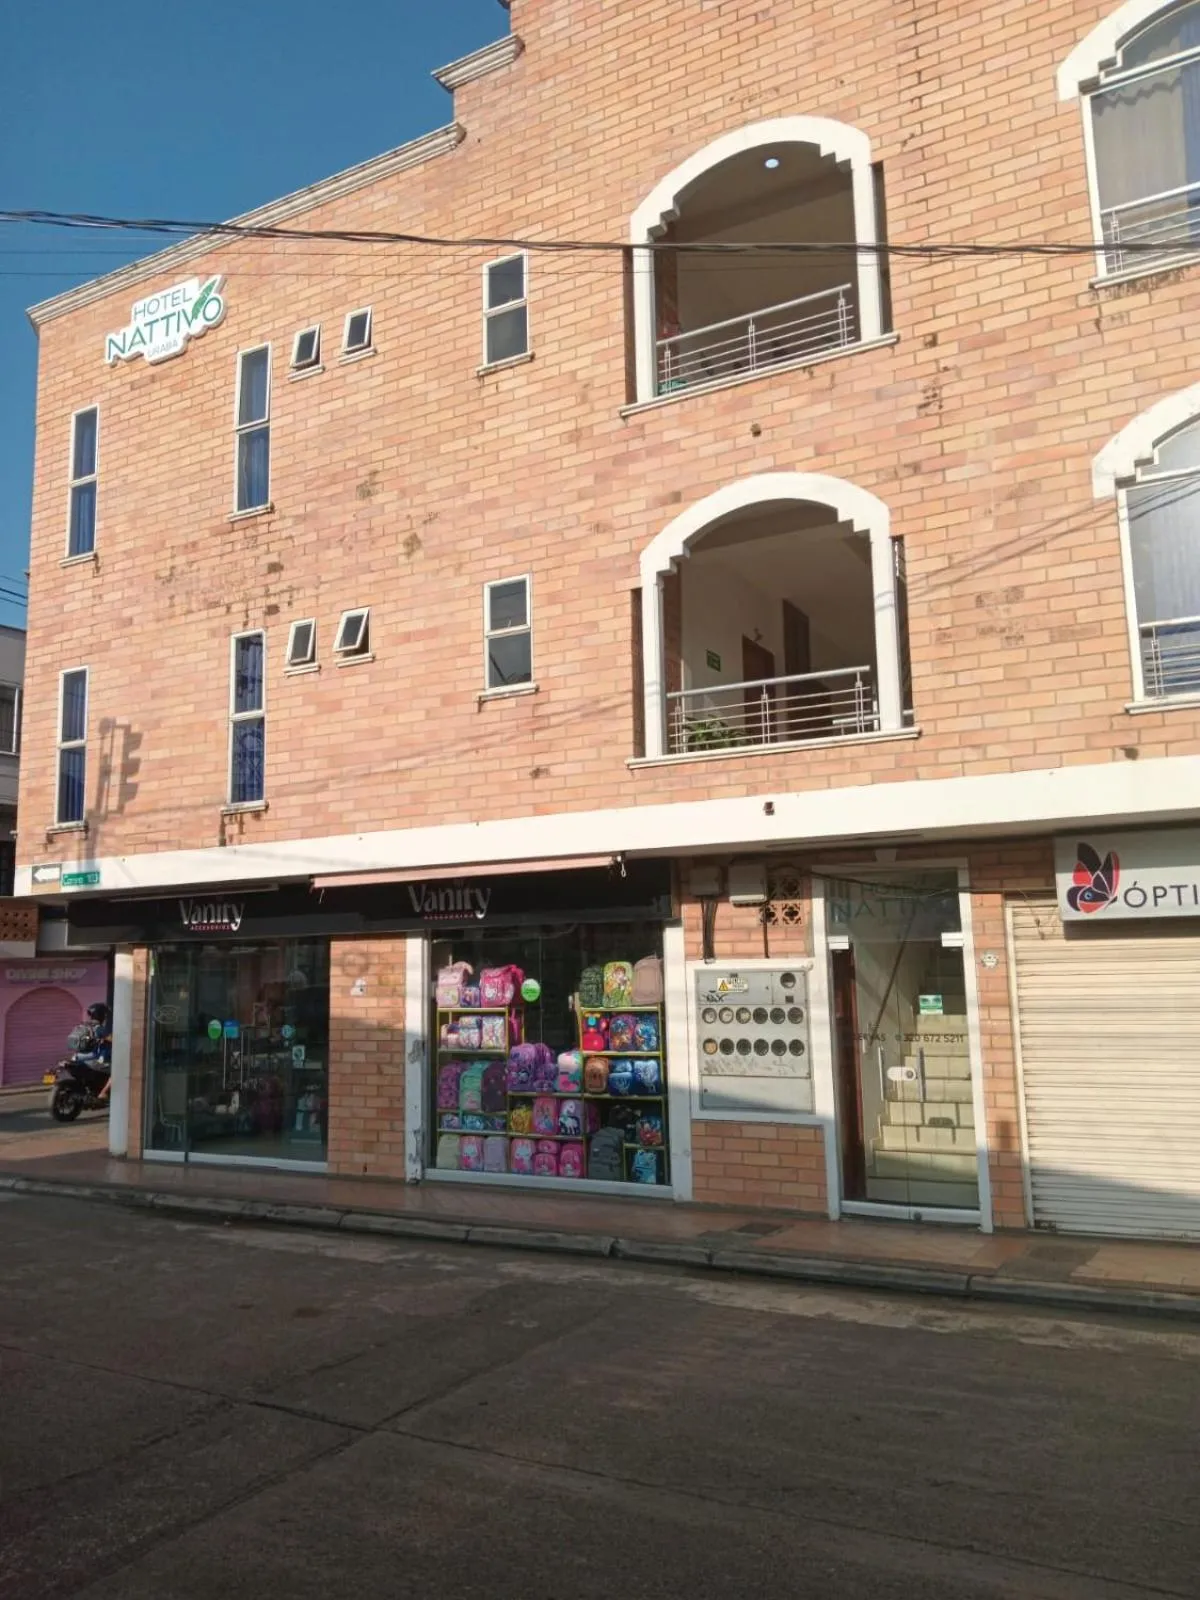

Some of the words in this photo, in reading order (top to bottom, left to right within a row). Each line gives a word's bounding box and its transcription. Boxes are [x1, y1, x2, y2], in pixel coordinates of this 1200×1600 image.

[108, 280, 222, 361] NATTIVO
[134, 287, 192, 321] HOTEL
[407, 881, 492, 920] Vanity
[1123, 881, 1199, 908] ÓPTI
[178, 897, 246, 931] Vanity
[943, 1034, 964, 1043] 5211
